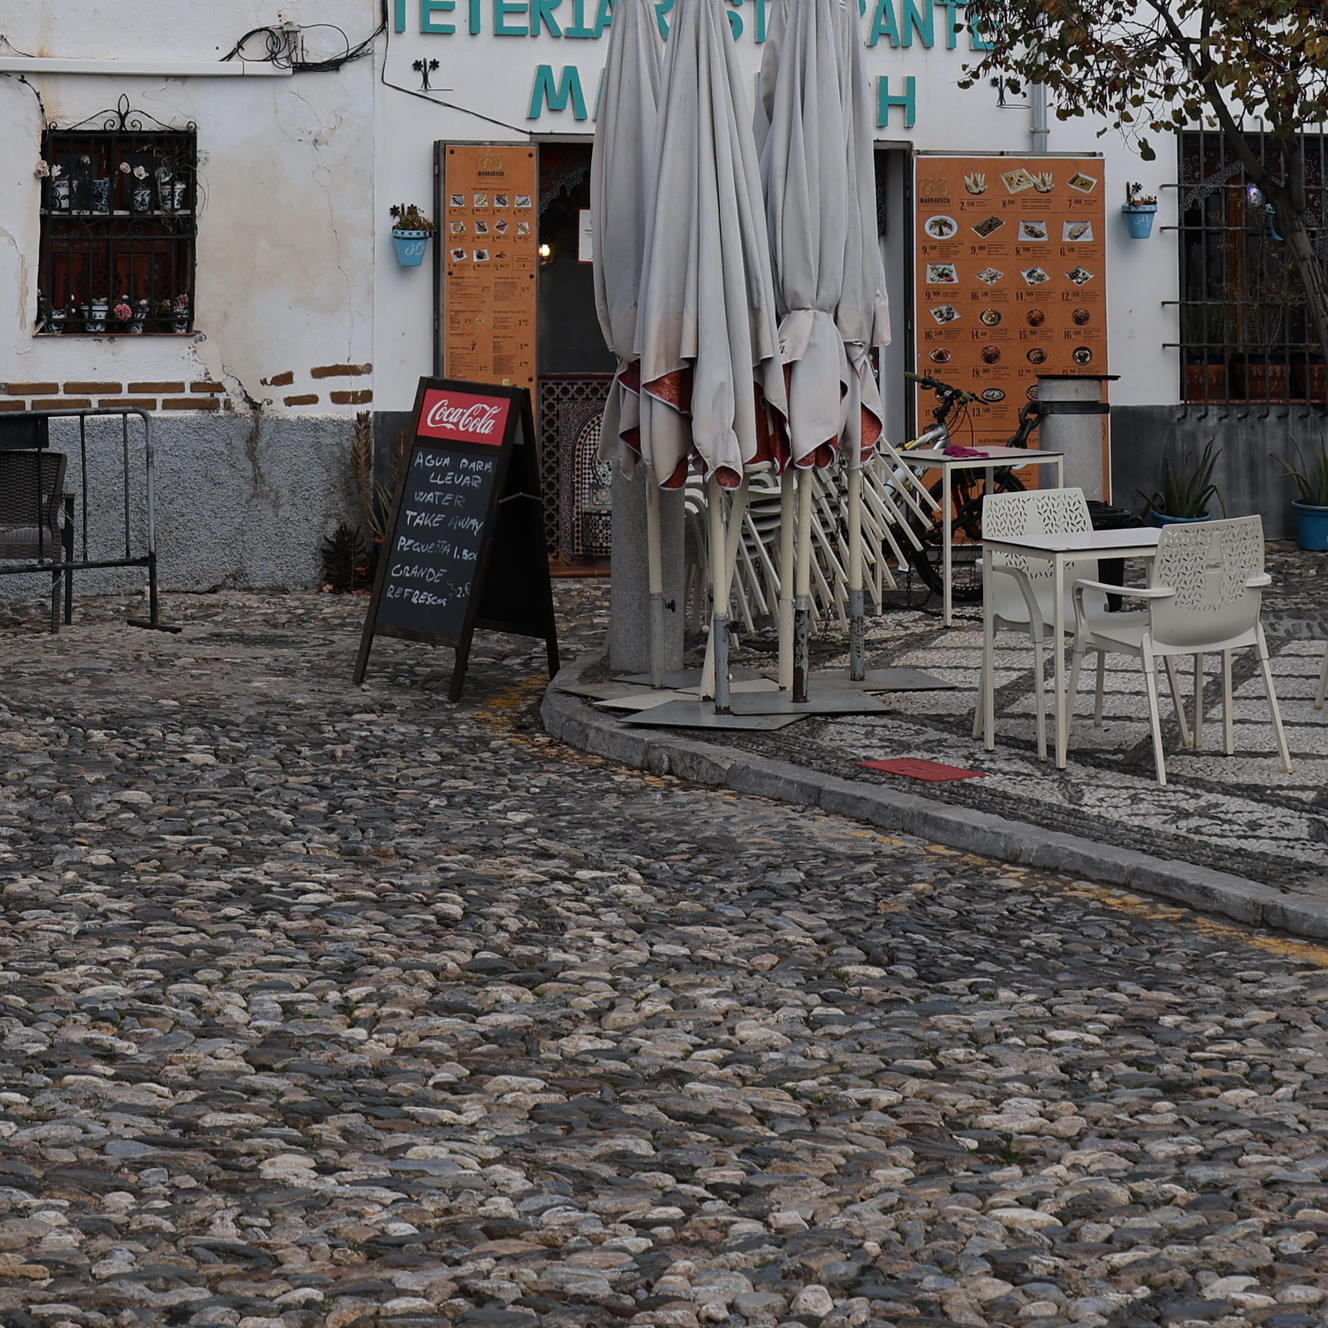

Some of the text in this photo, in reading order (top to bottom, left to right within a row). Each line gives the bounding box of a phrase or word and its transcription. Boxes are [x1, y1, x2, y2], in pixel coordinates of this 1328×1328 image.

[427, 399, 502, 435] Coca-Cola
[414, 451, 493, 473] AGUA PARA
[429, 471, 482, 489] LLEVAR
[414, 491, 466, 508] WATER
[406, 510, 446, 528] TAKE
[391, 563, 448, 583] GRANDE
